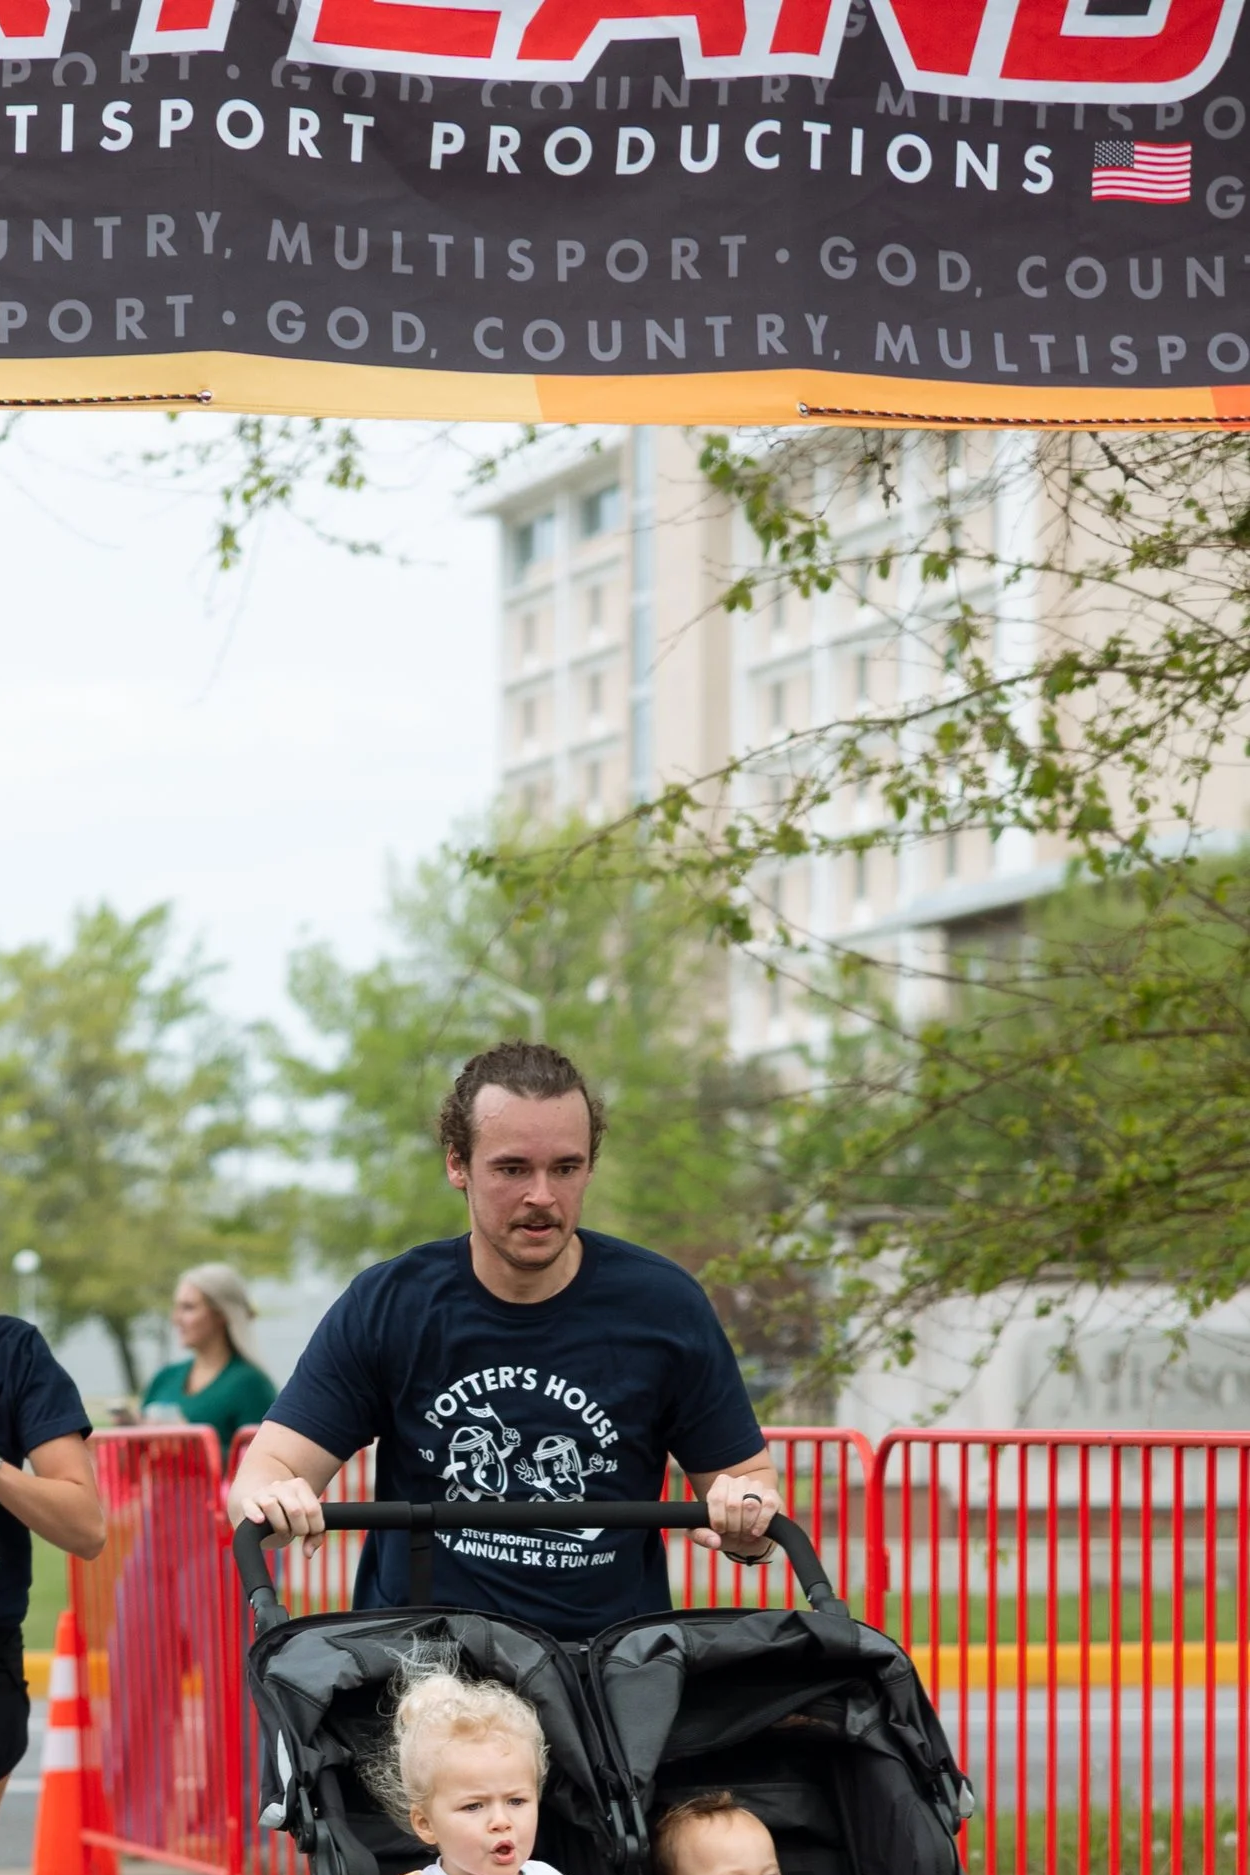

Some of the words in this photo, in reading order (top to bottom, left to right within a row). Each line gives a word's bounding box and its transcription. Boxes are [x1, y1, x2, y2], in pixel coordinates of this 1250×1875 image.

[429, 119, 1054, 195] PRODUCTIONS
[266, 218, 748, 283] MULTISPORT
[819, 236, 983, 298] GOD,
[1017, 255, 1250, 300] COUN
[266, 300, 438, 359] GOD,
[473, 313, 841, 363] COUNTRY,
[424, 1366, 537, 1429] POTTER'S
[544, 1375, 619, 1449] HOUSE
[453, 1539, 519, 1563] ANNUAL
[522, 1551, 542, 1566] 5K
[545, 1553, 557, 1567] &
[560, 1554, 589, 1568] FUN
[591, 1550, 617, 1566] RUN
[461, 1528, 491, 1541] STEVE
[493, 1533, 543, 1549] PROFFITT
[545, 1541, 583, 1553] LEGACY
